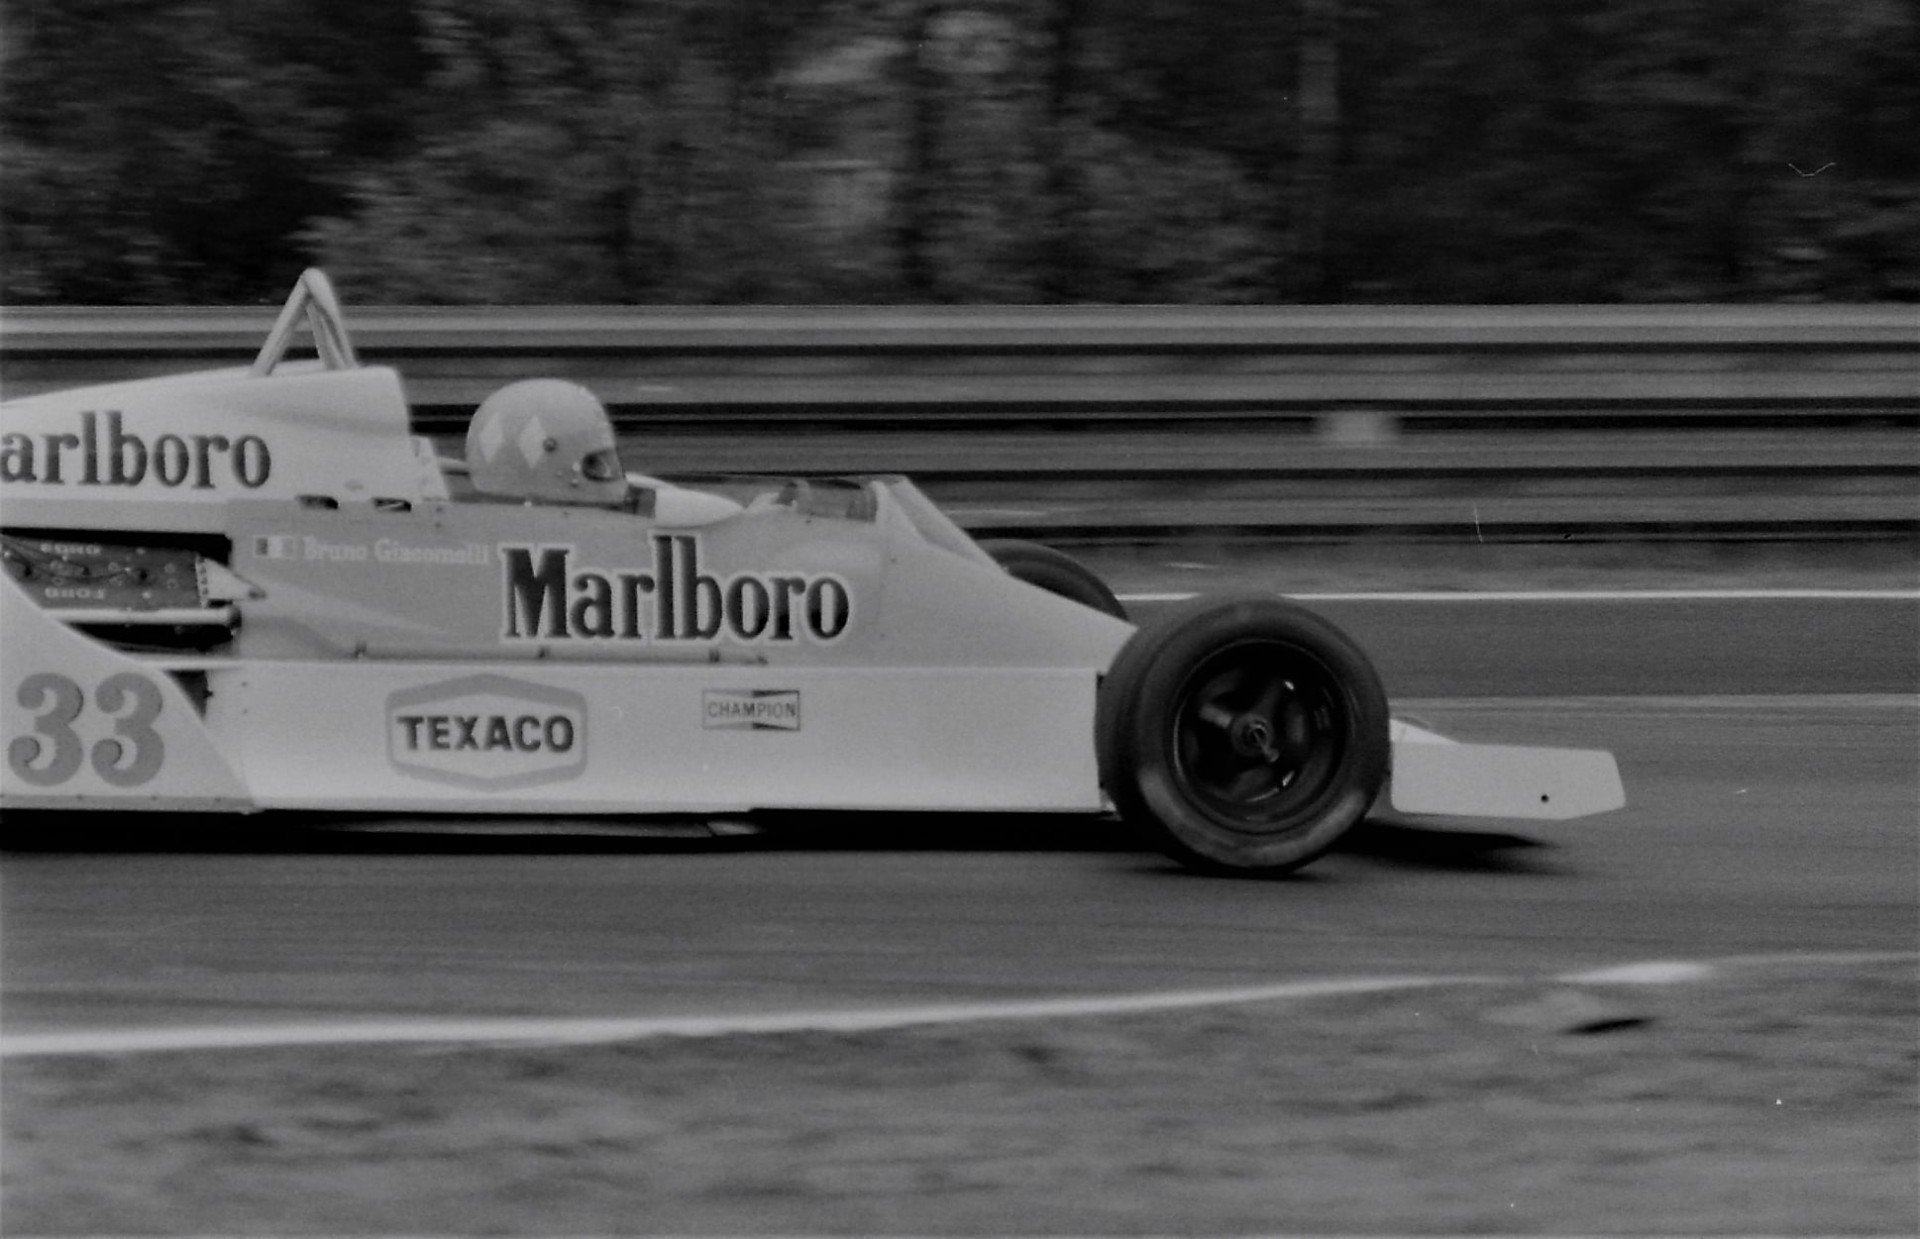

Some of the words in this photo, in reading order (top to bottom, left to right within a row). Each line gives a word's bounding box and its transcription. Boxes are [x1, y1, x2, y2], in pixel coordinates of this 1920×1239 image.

[0, 410, 271, 489] arlboro
[303, 536, 368, 562] Bruno
[374, 537, 489, 565] Giacomelli
[502, 534, 850, 641] Marlboro
[8, 672, 165, 786] 33
[396, 714, 575, 753] TEXACO
[706, 701, 797, 719] CHAMPION
